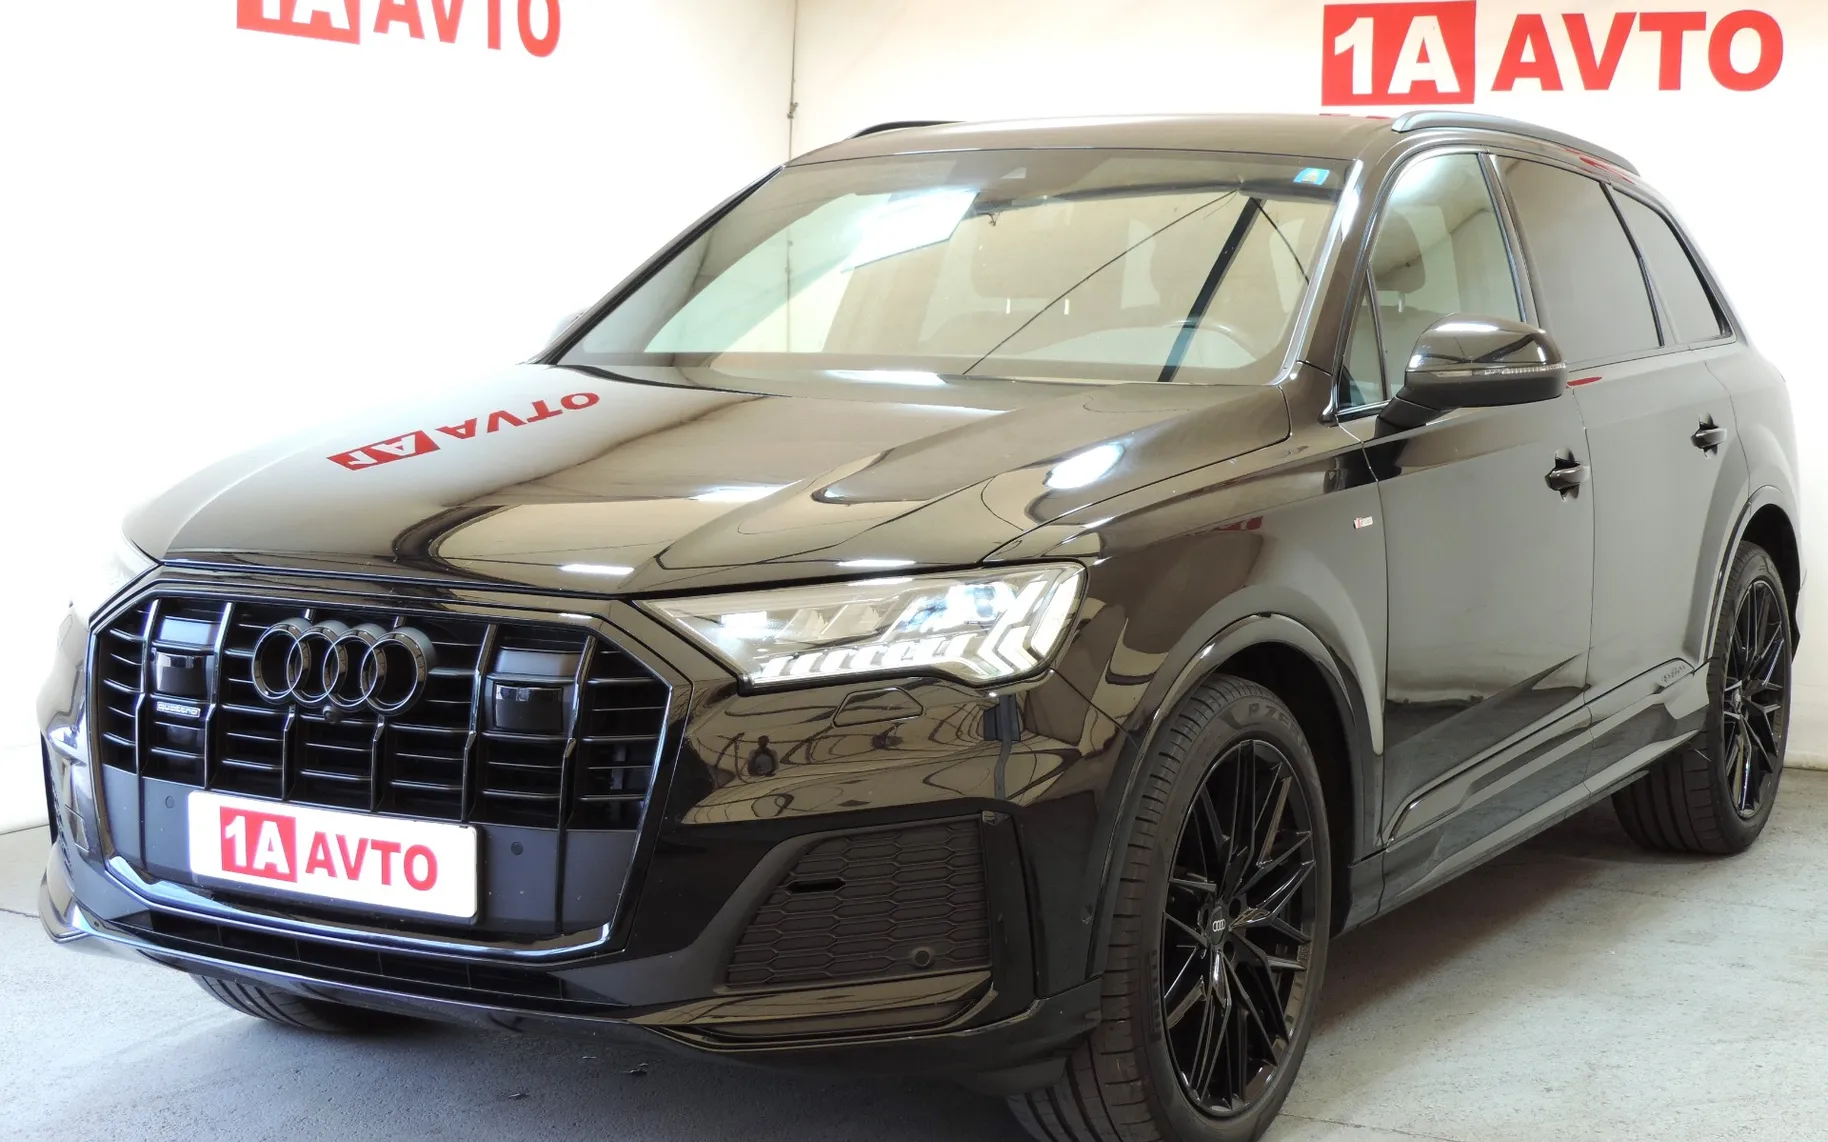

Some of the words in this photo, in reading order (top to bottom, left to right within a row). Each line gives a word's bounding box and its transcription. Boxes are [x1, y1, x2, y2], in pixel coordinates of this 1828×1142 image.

[1334, 15, 1461, 95] 1A
[1491, 9, 1783, 92] AVTO
[224, 815, 291, 875] 1A
[305, 831, 438, 891] AVTO
